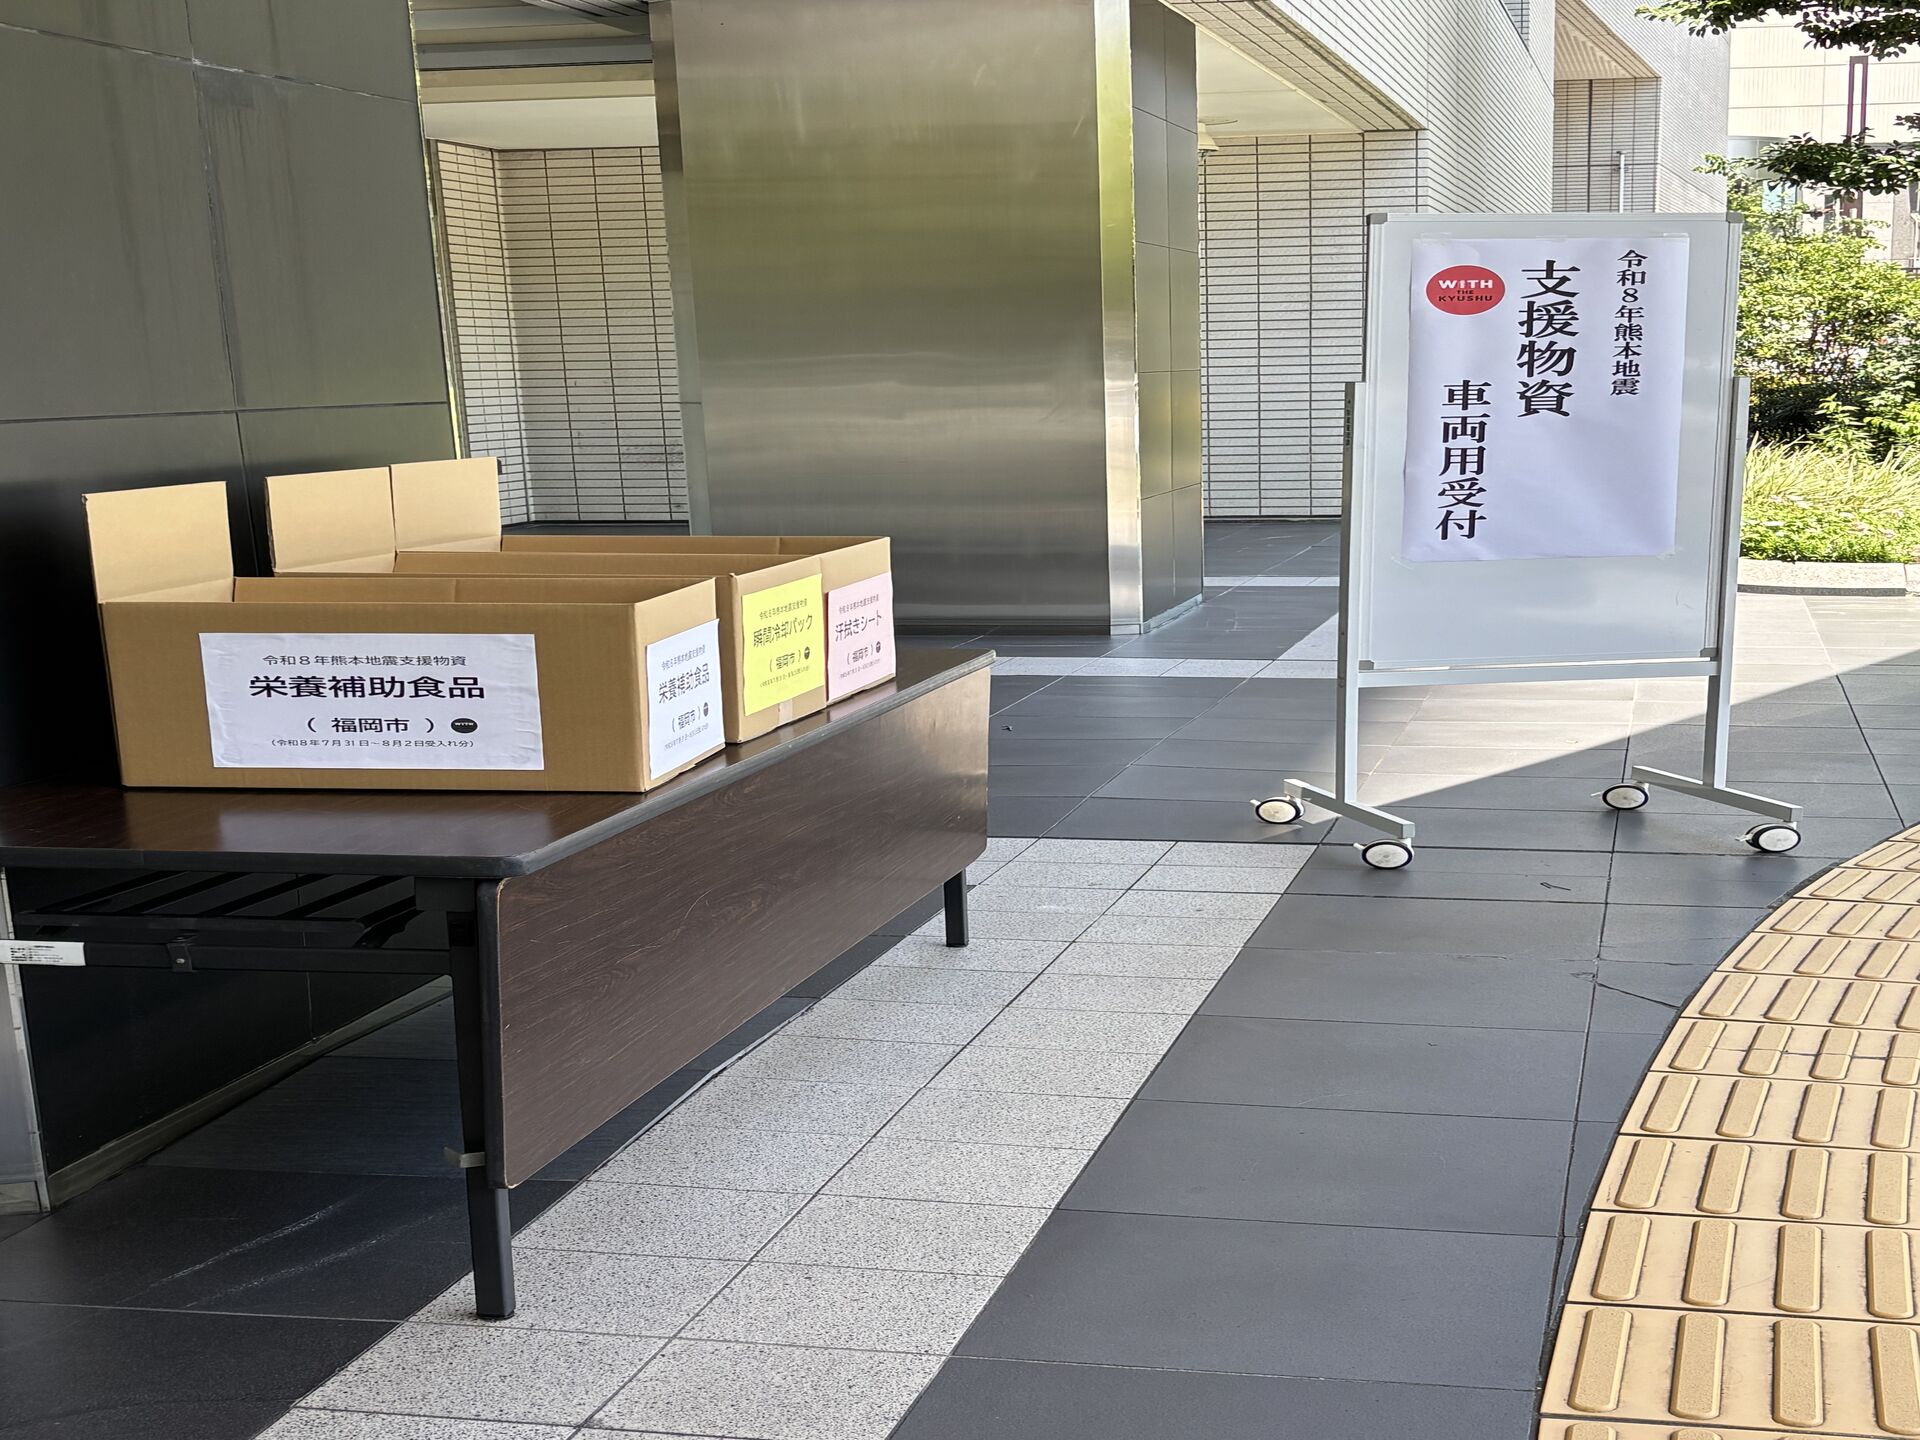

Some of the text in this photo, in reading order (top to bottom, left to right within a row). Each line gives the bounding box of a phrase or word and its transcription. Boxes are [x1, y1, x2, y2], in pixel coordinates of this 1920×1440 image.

[1438, 279, 1494, 289] WITH
[1438, 295, 1493, 303] KYUSHU
[1516, 259, 1581, 418] 支援物資
[1610, 249, 1648, 396] 令和8年熊本地震
[1434, 379, 1493, 541] 車両用受付
[753, 614, 813, 648] 瞬間冷却パック
[835, 609, 882, 642] 汗拭きシート
[262, 655, 467, 667] 令和8年熊本地震支援物資
[249, 676, 485, 699] 栄養補助食品
[658, 663, 710, 704] 栄養補助食品
